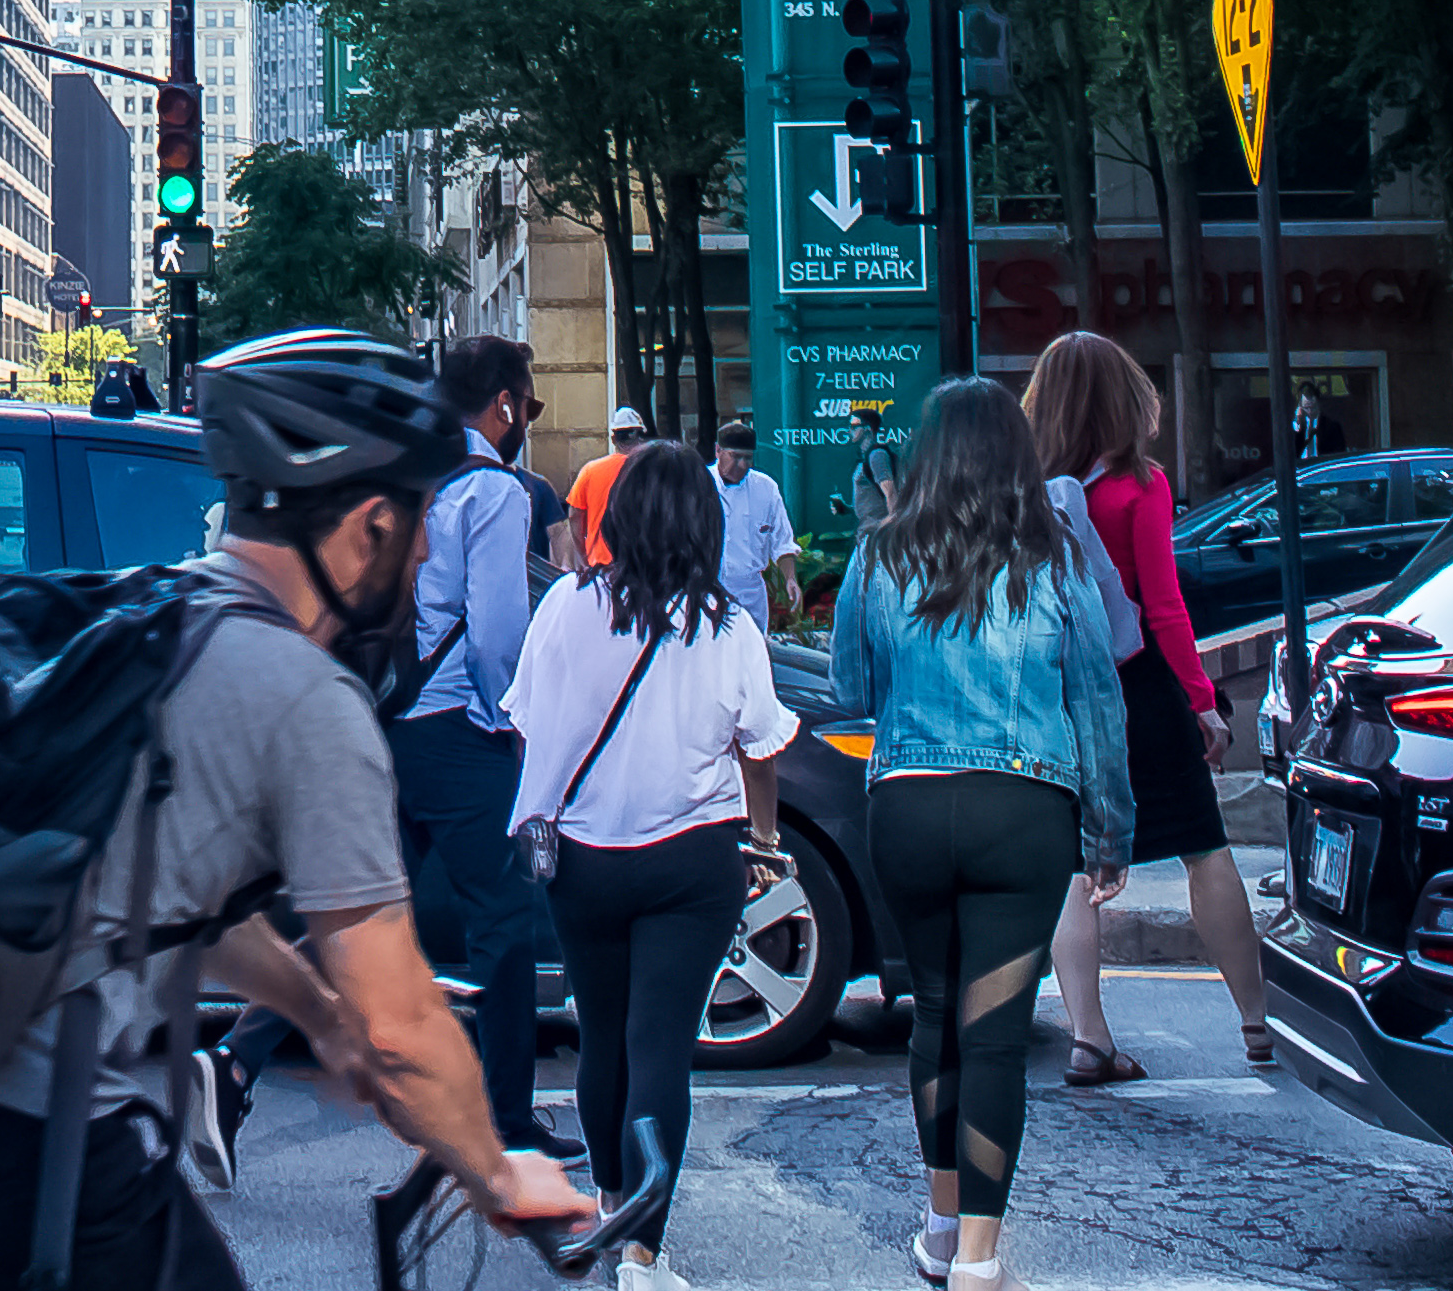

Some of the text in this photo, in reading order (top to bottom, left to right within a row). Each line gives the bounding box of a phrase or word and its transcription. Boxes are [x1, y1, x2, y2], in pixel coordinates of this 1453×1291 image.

[784, 1, 840, 17] 345 N.
[803, 242, 900, 258] The Sterling
[789, 259, 916, 282] SELF PARK
[53, 293, 81, 302] HOTE
[787, 344, 922, 362] CVS PHARMACY
[815, 372, 895, 389] 7-ELEVEN
[773, 428, 850, 445] STERLING
